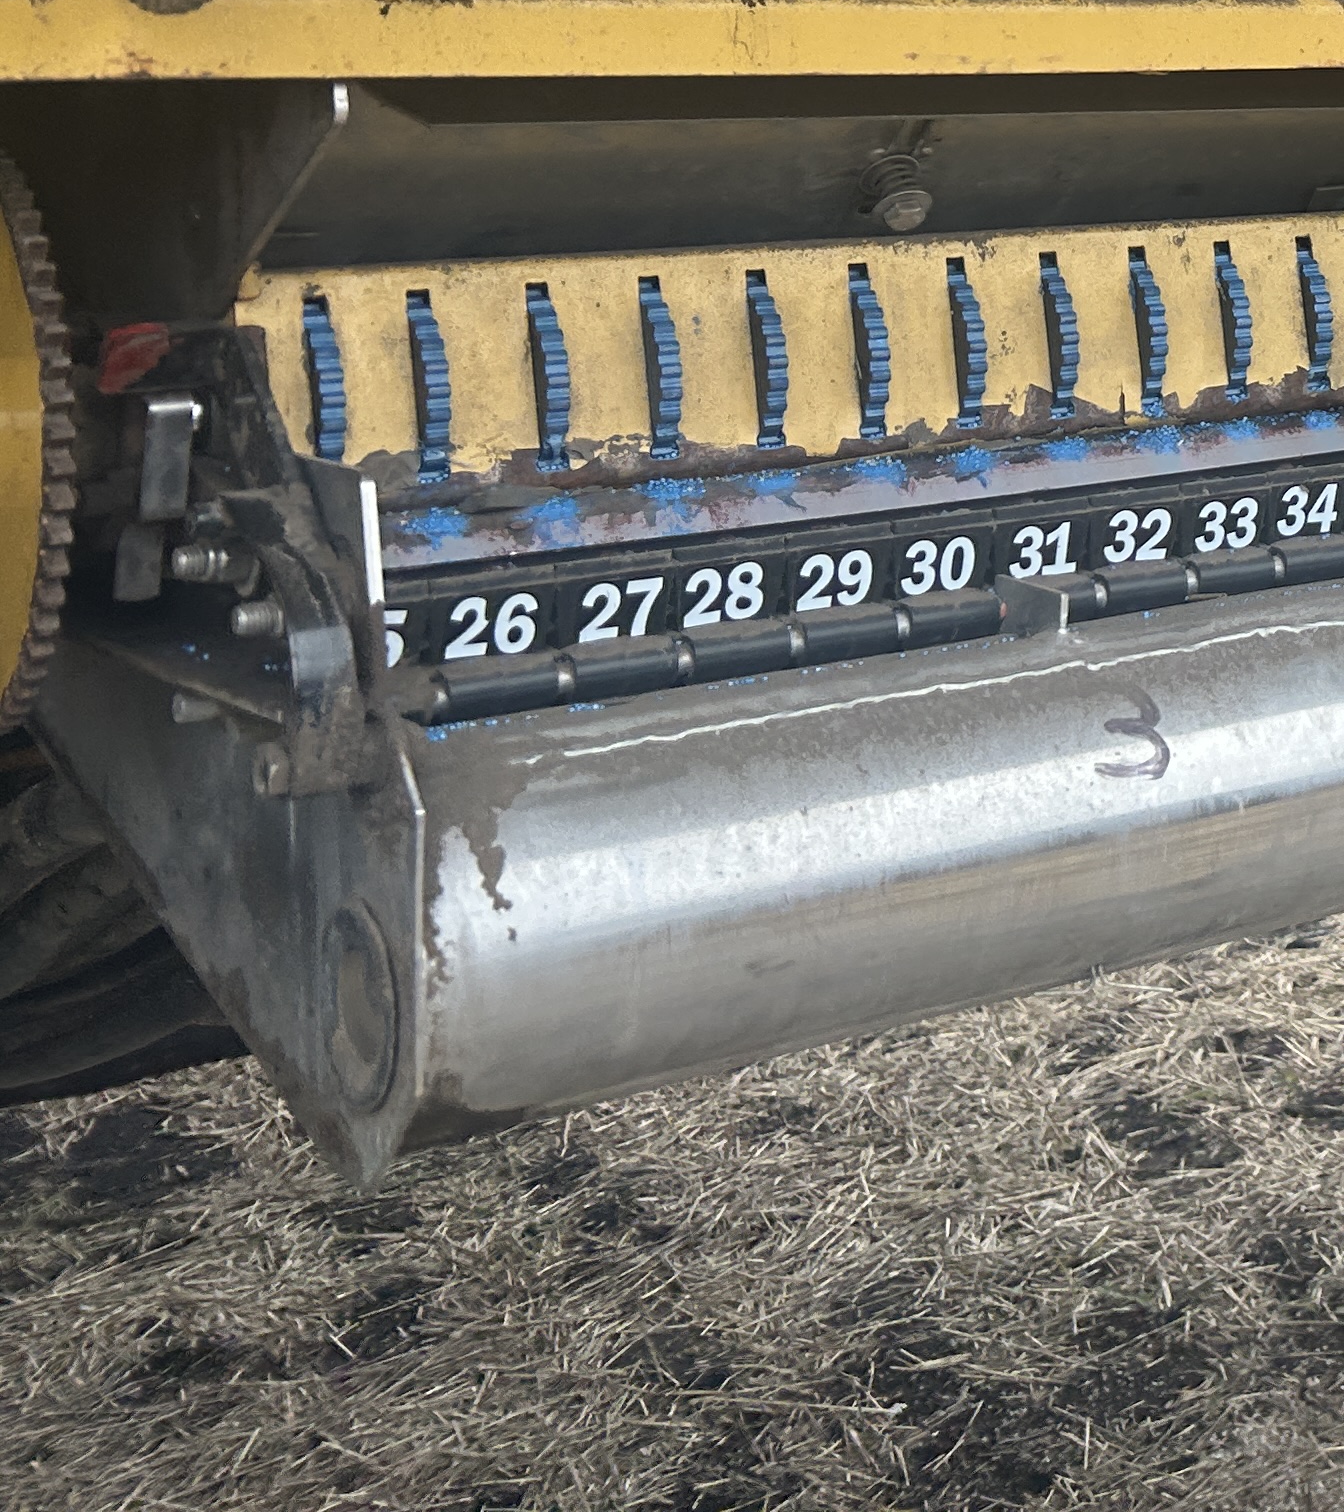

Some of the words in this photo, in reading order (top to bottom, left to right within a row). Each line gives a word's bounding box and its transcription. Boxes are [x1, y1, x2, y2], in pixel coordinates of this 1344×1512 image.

[383, 609, 408, 668] 5
[445, 592, 539, 660] 26
[578, 576, 664, 644] 27
[683, 561, 764, 629] 28
[796, 549, 873, 612] 29
[900, 536, 976, 596] 30
[1008, 521, 1077, 580] 31
[1103, 508, 1172, 563] 32
[1194, 497, 1259, 553] 33
[1276, 483, 1338, 537] 34
[1094, 683, 1171, 780] 3
